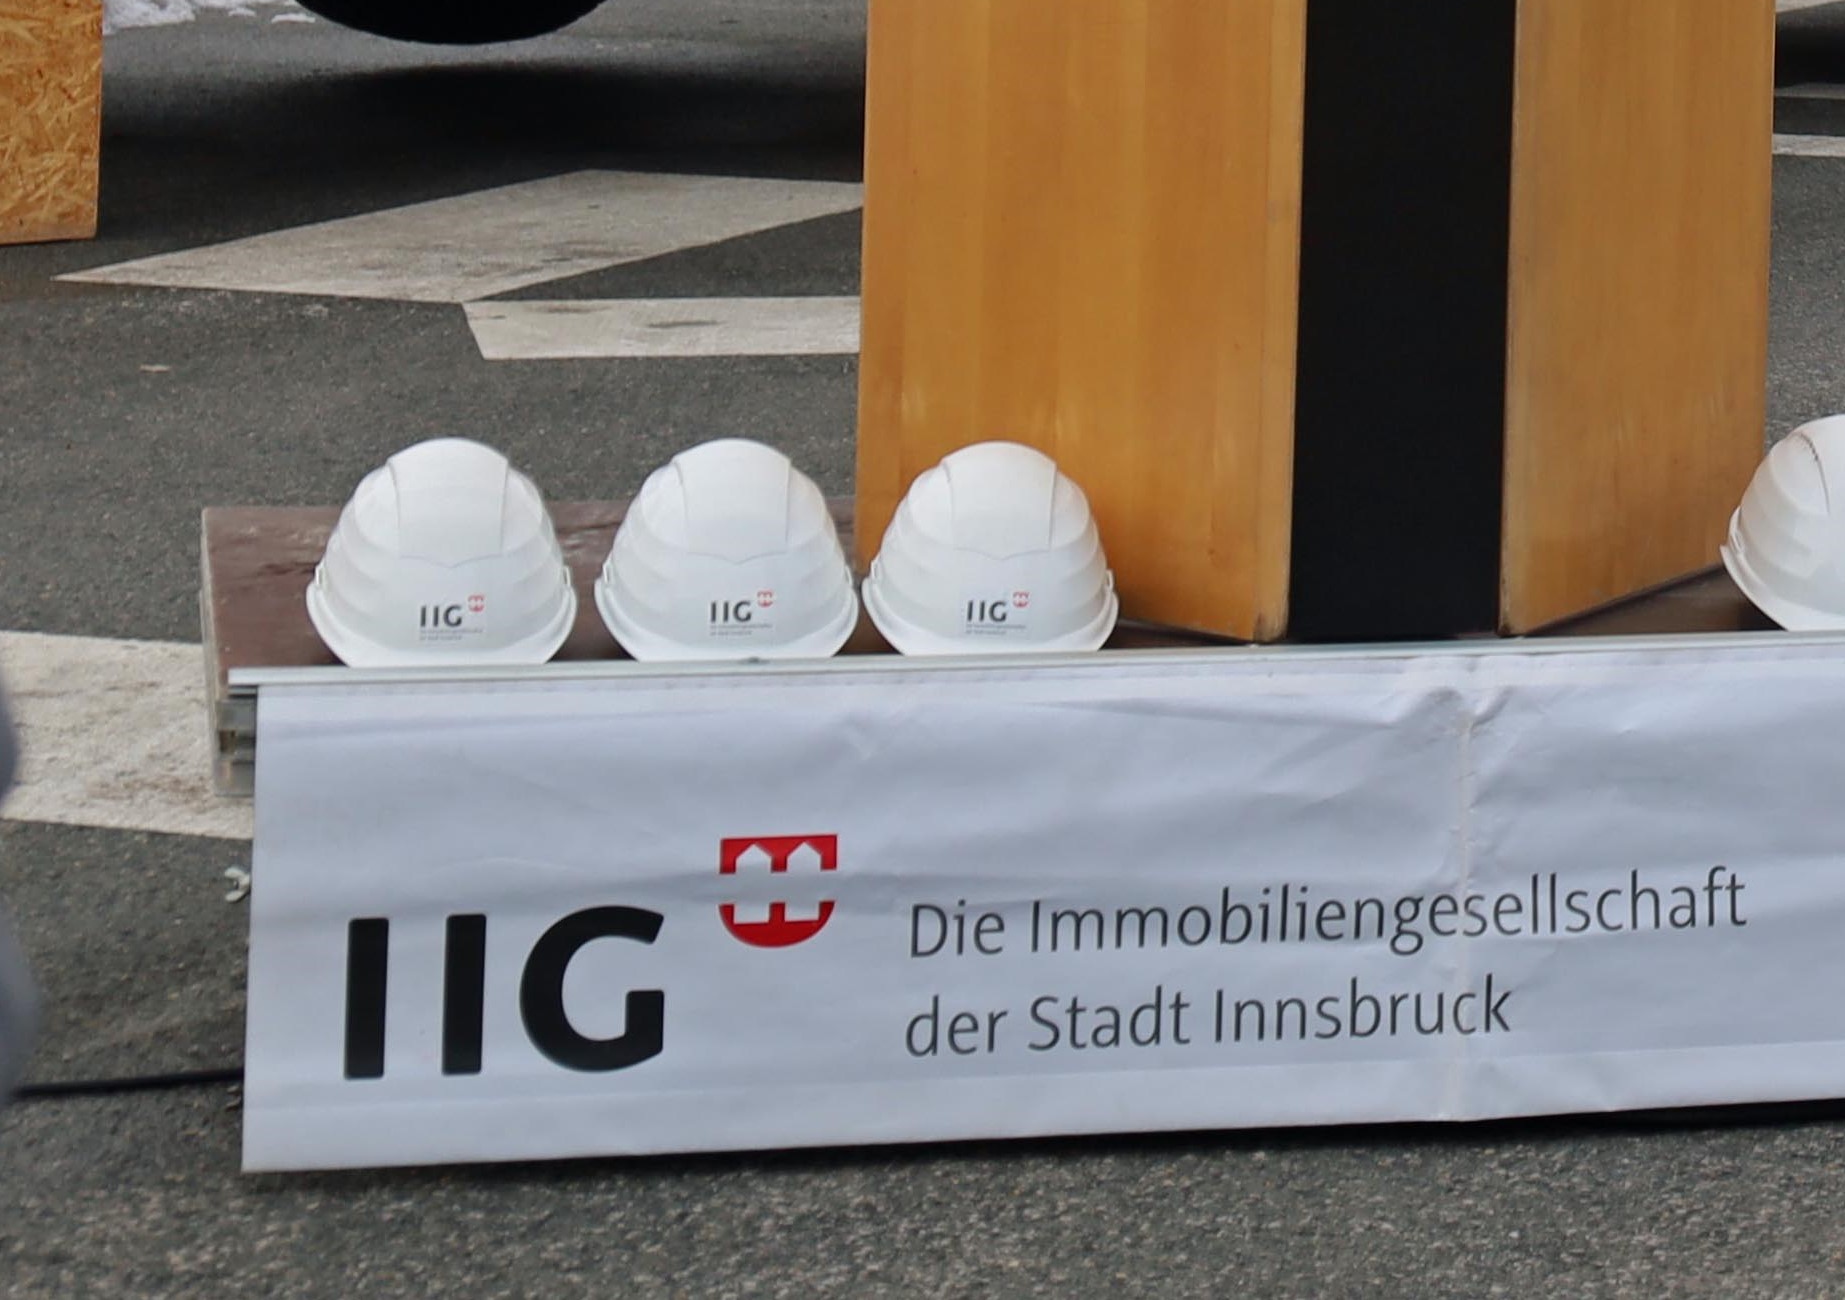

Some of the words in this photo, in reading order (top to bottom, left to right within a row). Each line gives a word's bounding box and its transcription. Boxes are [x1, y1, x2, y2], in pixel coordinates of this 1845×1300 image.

[420, 604, 463, 628] IIG
[709, 600, 752, 623] IIG
[967, 600, 1007, 622] IIG
[909, 901, 1005, 958] Die
[1030, 865, 1748, 956] Immobiliengesellschaft
[343, 904, 666, 1080] IIG
[904, 994, 1008, 1058] der
[1027, 984, 1192, 1052] Stadt
[1213, 973, 1513, 1044] Innsbruck
